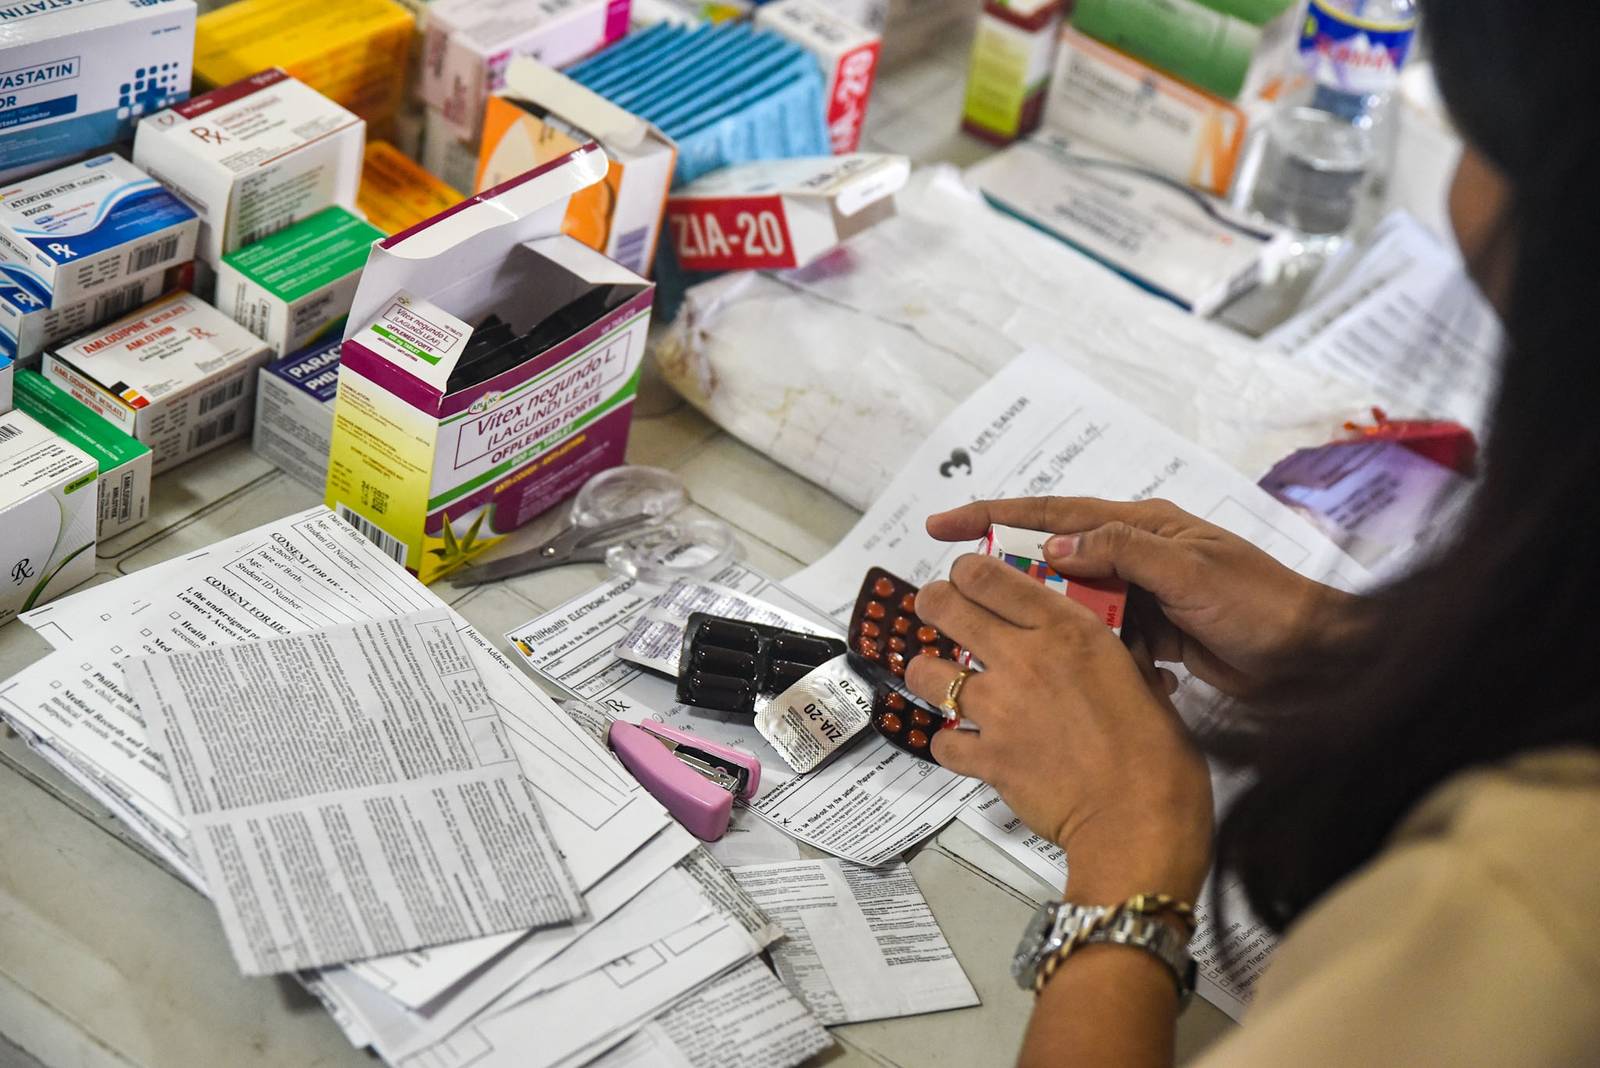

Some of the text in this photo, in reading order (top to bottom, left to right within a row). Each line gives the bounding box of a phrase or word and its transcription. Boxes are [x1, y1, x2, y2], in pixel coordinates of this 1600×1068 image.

[10, 182, 76, 208] ATORVASTATIN
[671, 211, 784, 257] ZIA-20
[48, 243, 78, 258] Rx
[83, 320, 150, 354] AMLODIPINE
[392, 317, 440, 346] (LAGUNDI LEAF)
[396, 308, 414, 320] Vitex
[412, 319, 444, 339] negundo
[386, 324, 433, 352] OFPLEMED FORTE
[289, 345, 341, 378] PARAC
[305, 367, 339, 390] PHIL
[477, 348, 617, 436] Vitex negundo L.
[487, 372, 603, 450] (LAGUNDI LEAF)
[491, 393, 602, 464] OFPLEMED FORTE
[303, 523, 328, 544] Student
[325, 540, 336, 550] ID
[328, 513, 343, 527] Date
[341, 524, 352, 534] of
[258, 550, 275, 564] Date
[274, 561, 286, 570] of
[270, 531, 329, 579] CONSENT FOR
[235, 562, 263, 583] Student
[261, 580, 274, 590] ID
[192, 590, 207, 603] the
[205, 599, 253, 636] undersigned
[205, 575, 252, 608] CONSENT
[249, 606, 272, 624] FOR
[176, 592, 213, 620] Learner's
[210, 618, 238, 638] Access
[525, 617, 568, 643] PhilHealth
[567, 595, 608, 620] ELECTRONIC
[181, 619, 208, 642] Health
[466, 629, 486, 648] Home
[547, 643, 567, 656] filled-out
[582, 625, 599, 637] facility
[142, 644, 156, 655] exa
[154, 637, 173, 653] Med
[64, 688, 96, 715] Medical
[92, 671, 135, 704] PhilHealth
[839, 679, 874, 716] ZIA-20
[605, 698, 631, 713] Rx
[803, 703, 843, 743] ZIA-20
[793, 826, 803, 834] To
[807, 808, 828, 823] filled-out
[826, 802, 835, 810] by
[833, 796, 842, 804] the
[841, 785, 858, 798] patient
[1003, 817, 1021, 831] Birth
[1022, 834, 1041, 847] PAR
[1037, 842, 1054, 853] Pas
[1047, 849, 1065, 861] Dise
